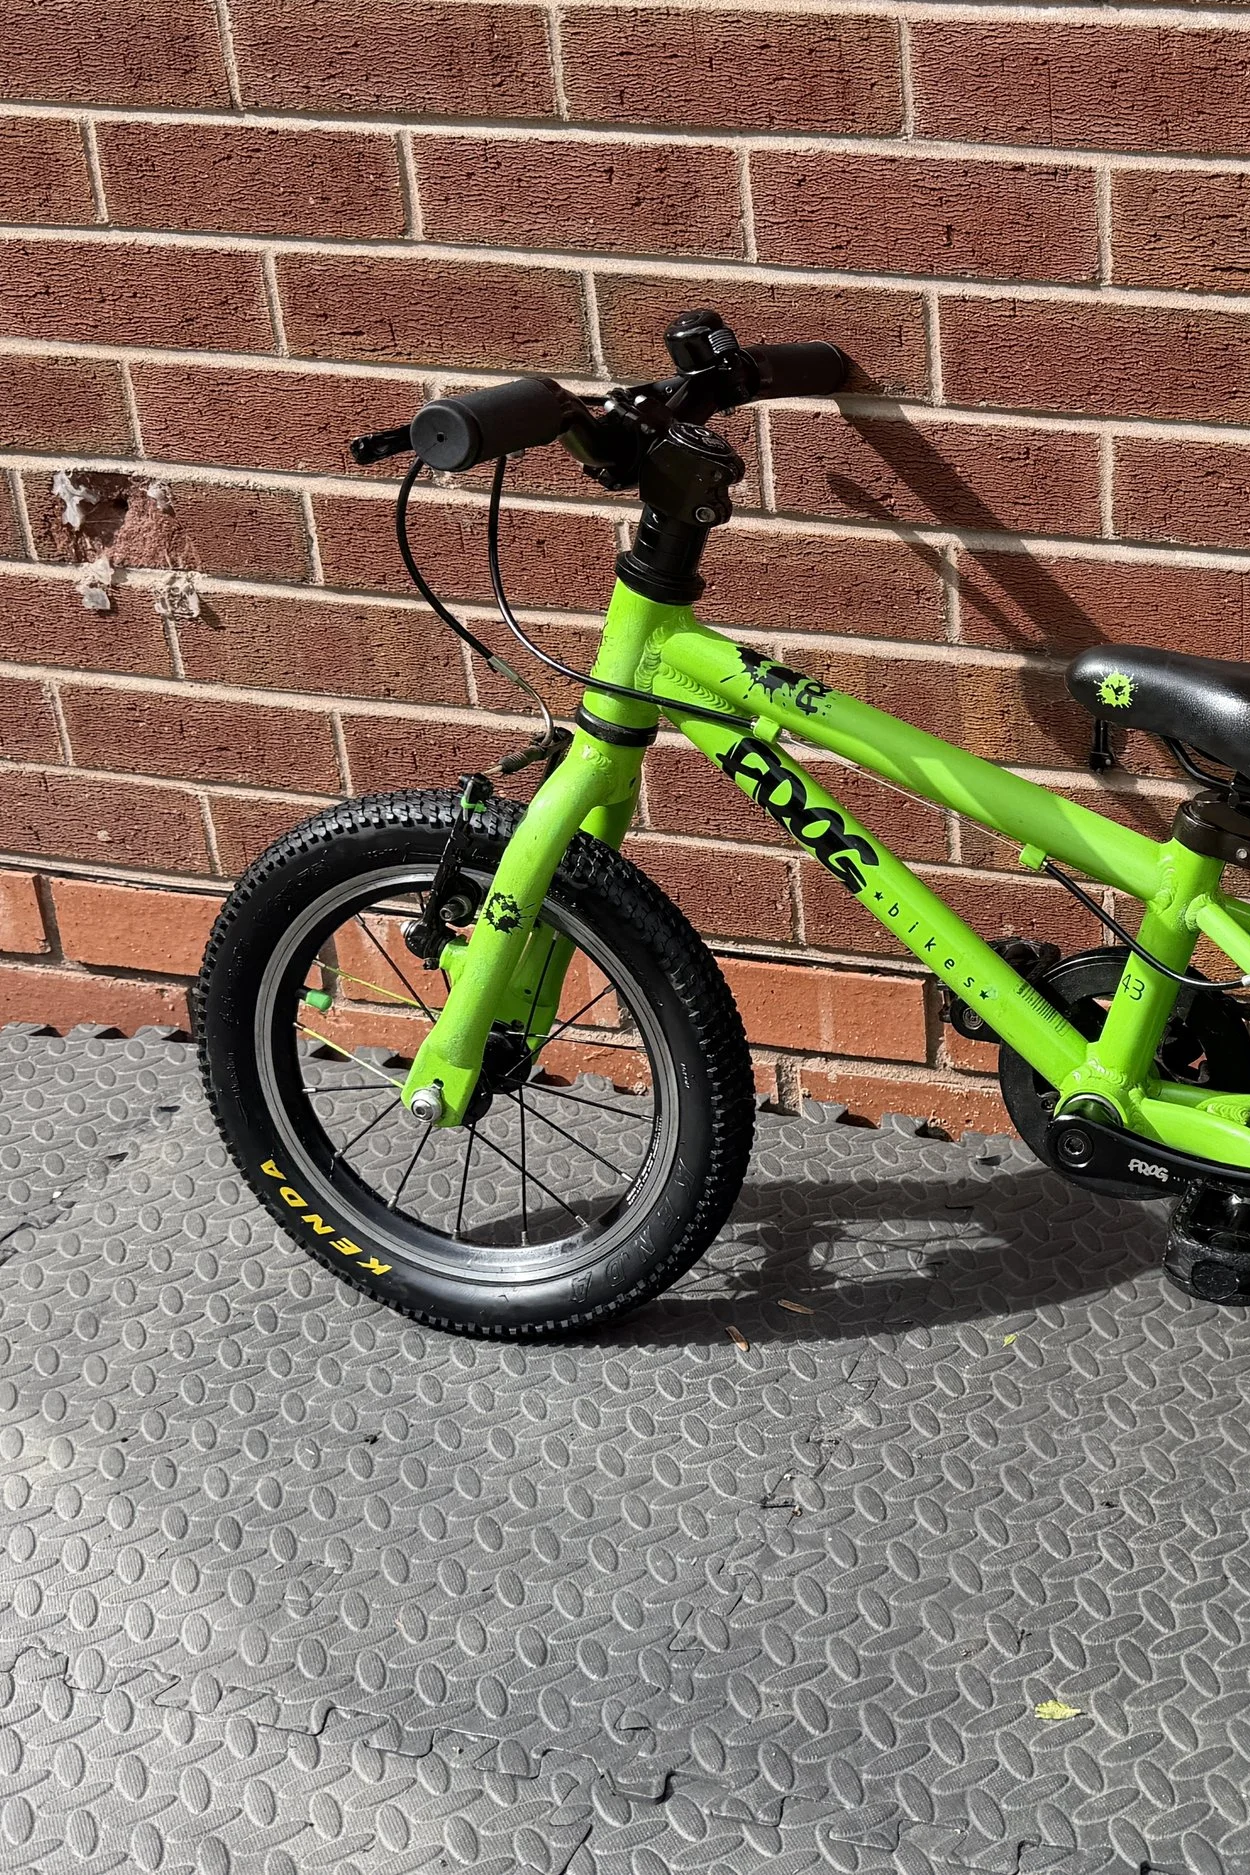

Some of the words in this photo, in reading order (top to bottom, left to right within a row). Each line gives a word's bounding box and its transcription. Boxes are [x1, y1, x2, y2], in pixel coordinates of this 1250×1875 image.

[716, 736, 880, 894] FROG
[887, 902, 975, 988] bikes
[1122, 973, 1145, 1000] 43
[1128, 1158, 1169, 1182] FROG
[260, 1158, 393, 1276] KENDA
